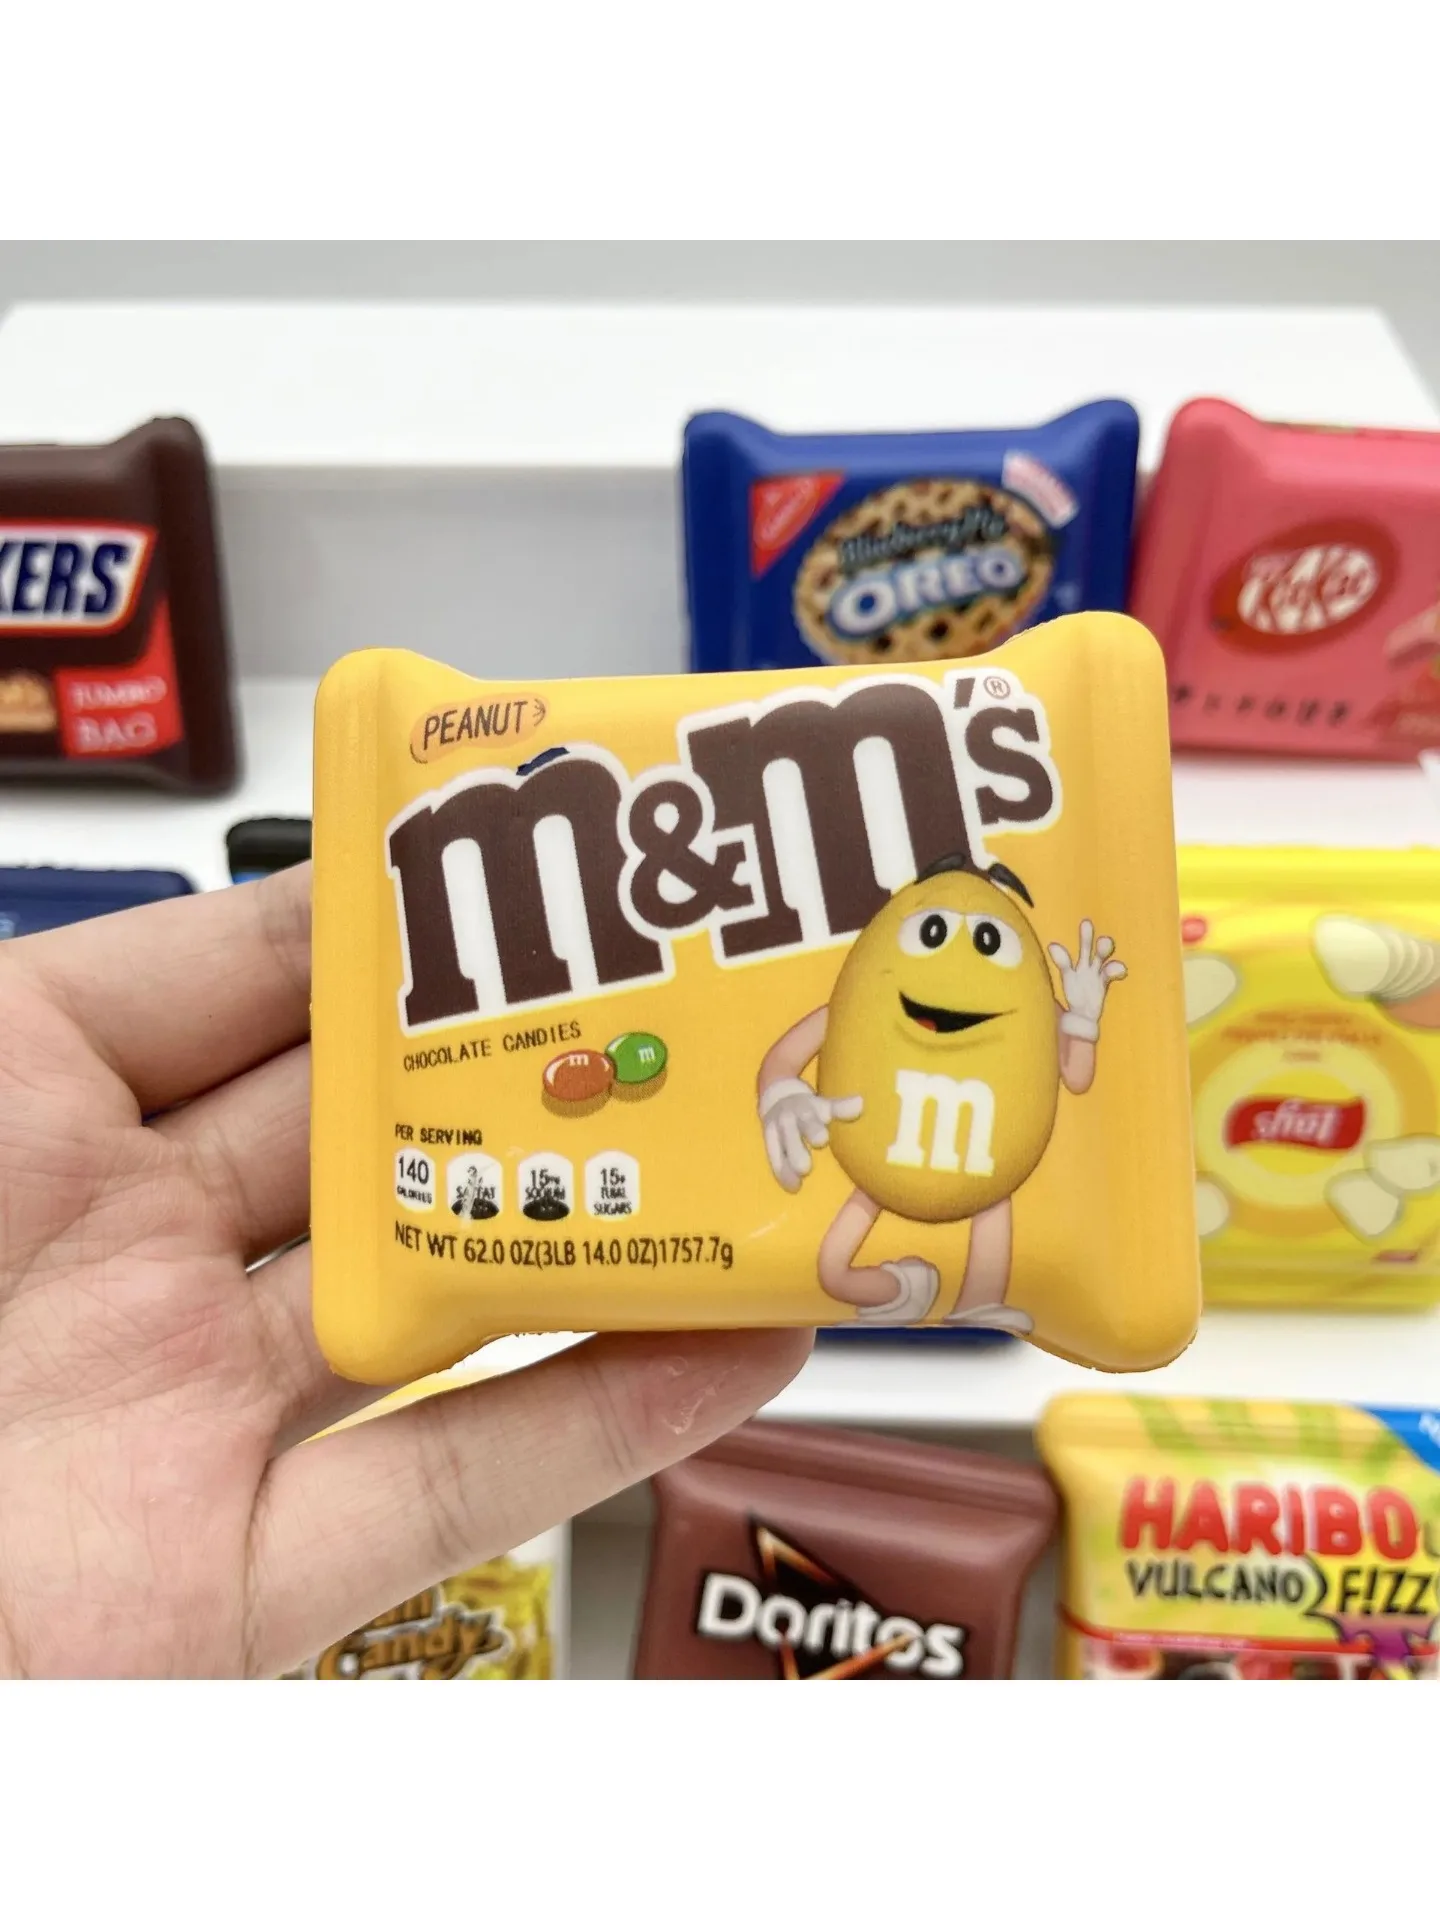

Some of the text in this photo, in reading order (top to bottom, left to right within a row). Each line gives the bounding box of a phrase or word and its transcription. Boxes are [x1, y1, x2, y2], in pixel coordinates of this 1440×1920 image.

[831, 550, 1021, 635] OREO
[423, 700, 528, 750] PEANUT
[403, 1021, 582, 1072] CHOCOLATE CANDIES
[395, 1123, 483, 1146] PER SERVING
[885, 1068, 996, 1177] m
[398, 1155, 430, 1185] 140
[395, 1219, 422, 1252] NET
[427, 1230, 458, 1261] WT
[464, 1236, 505, 1266] 62.0
[583, 1237, 622, 1266] 14.0
[1120, 1475, 1419, 1561] HARIBO
[1126, 1559, 1306, 1603] VULCANO
[698, 1573, 965, 1678] Doritos
